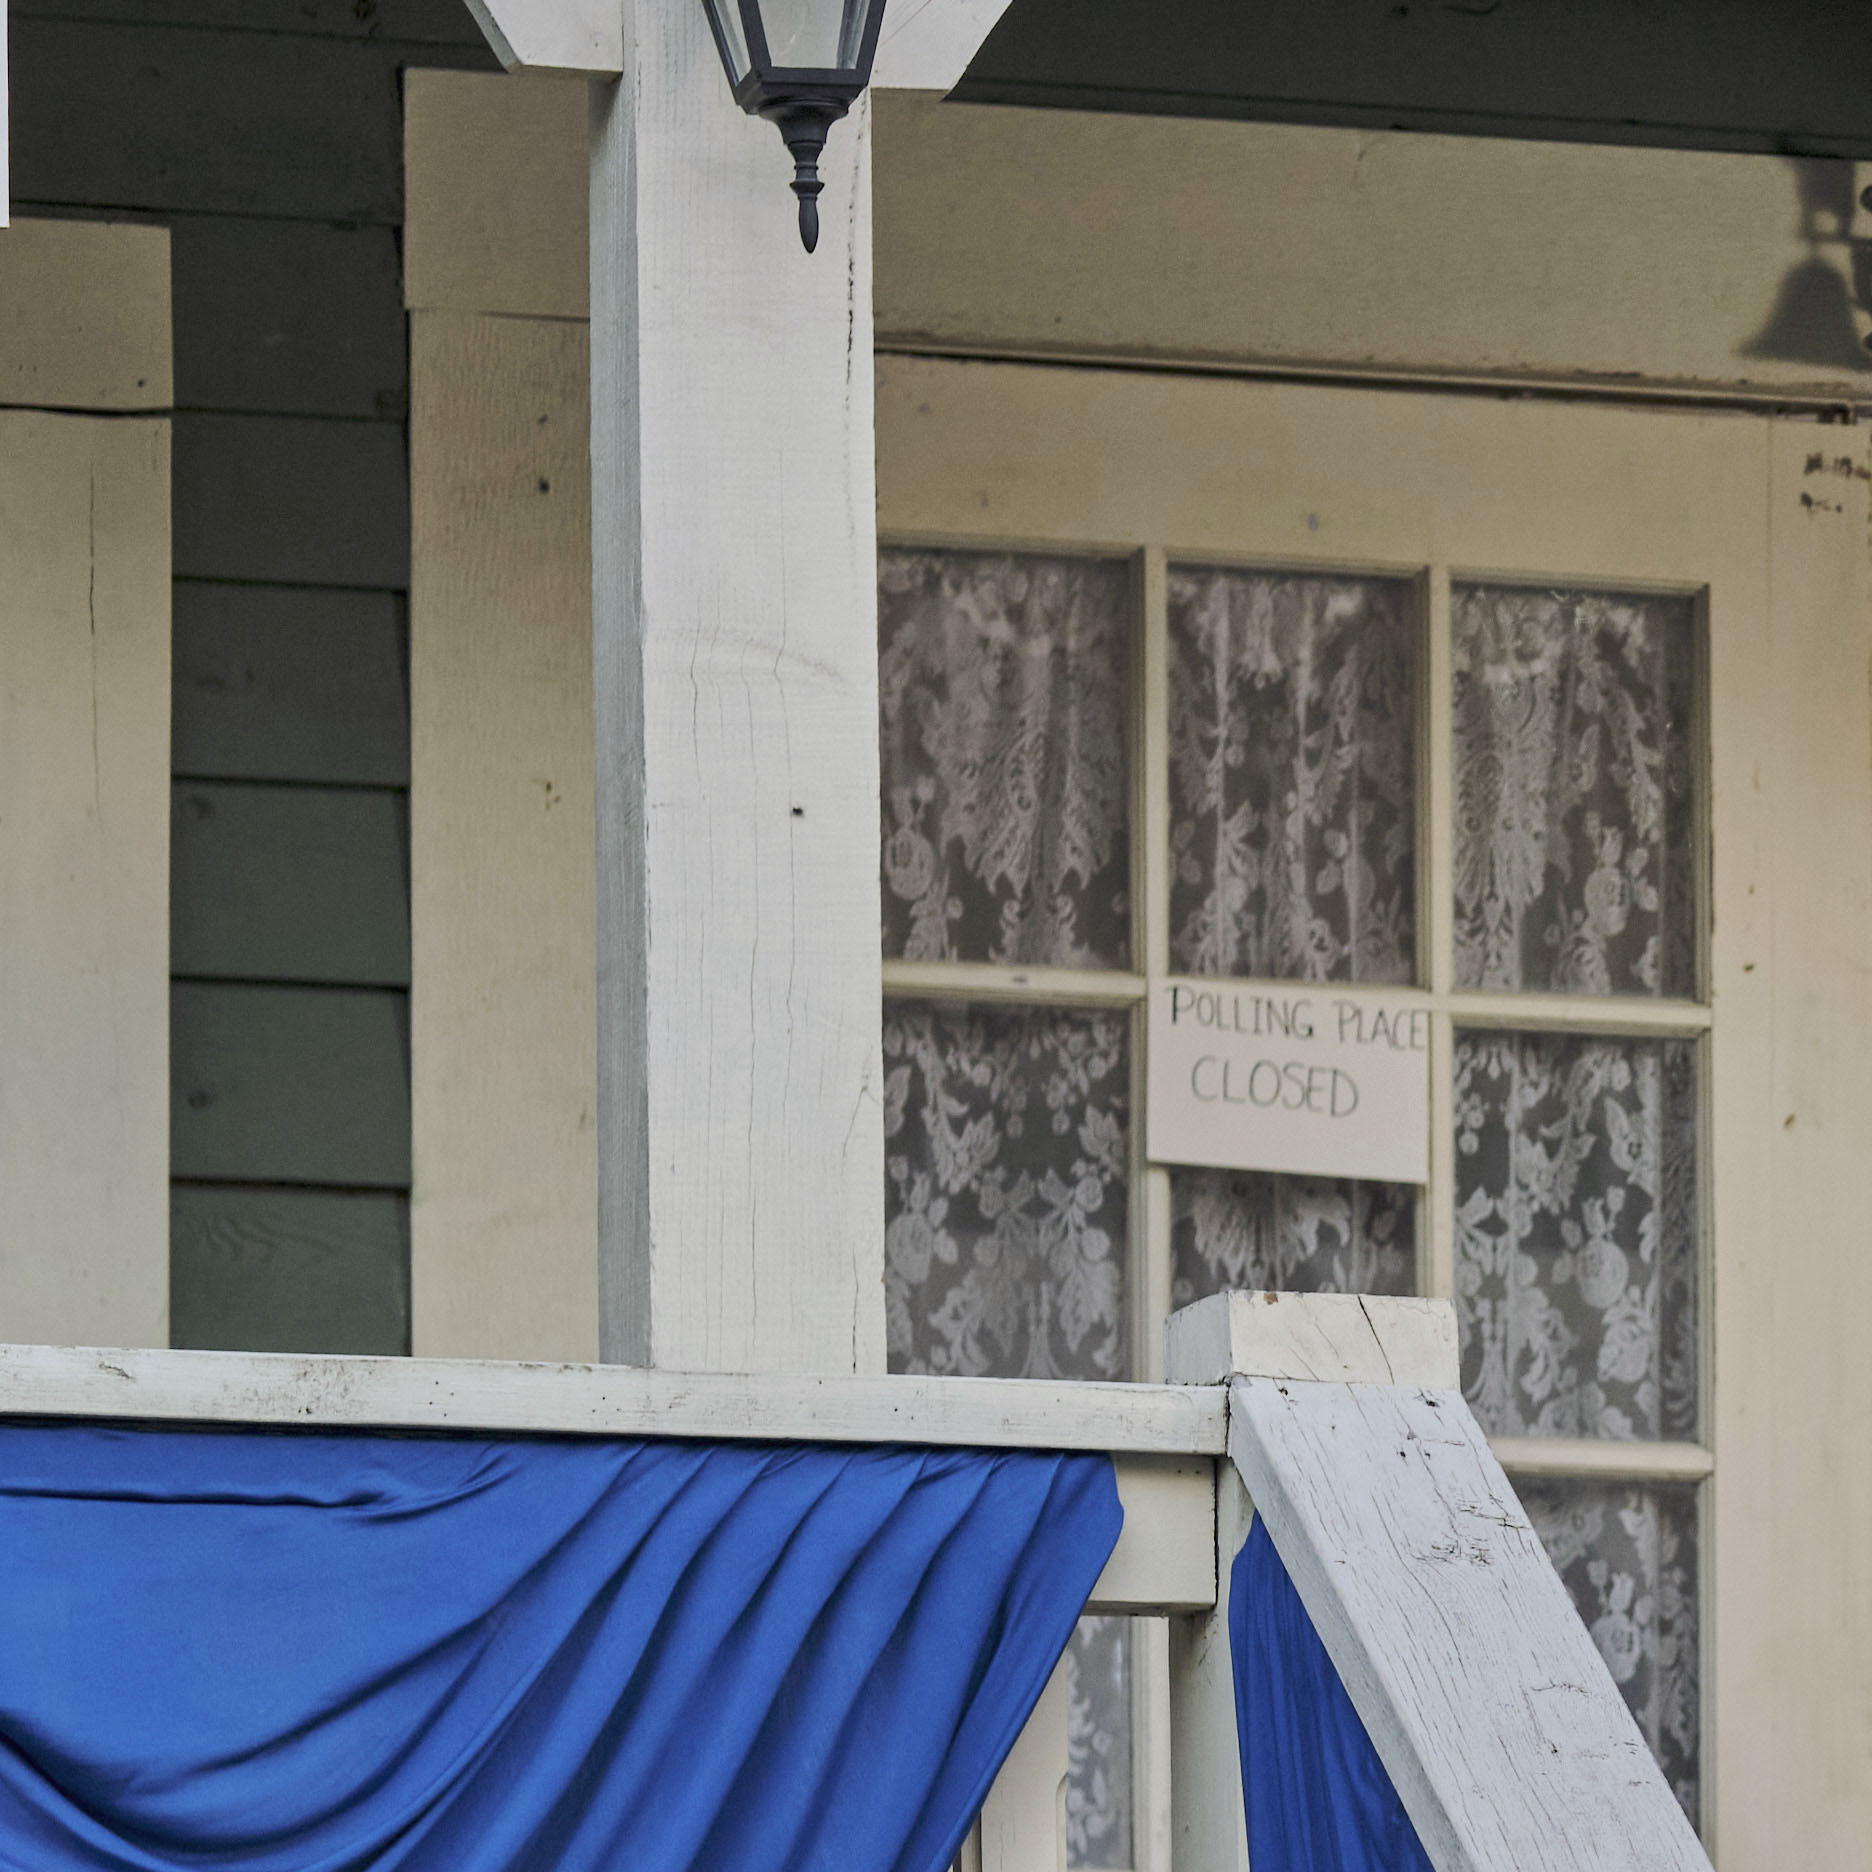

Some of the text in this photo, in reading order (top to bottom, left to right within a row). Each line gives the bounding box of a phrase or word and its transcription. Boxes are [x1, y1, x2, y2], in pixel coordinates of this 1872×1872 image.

[1165, 984, 1427, 1051] POLLING PLACE
[1191, 1055, 1359, 1118] CLOSED
